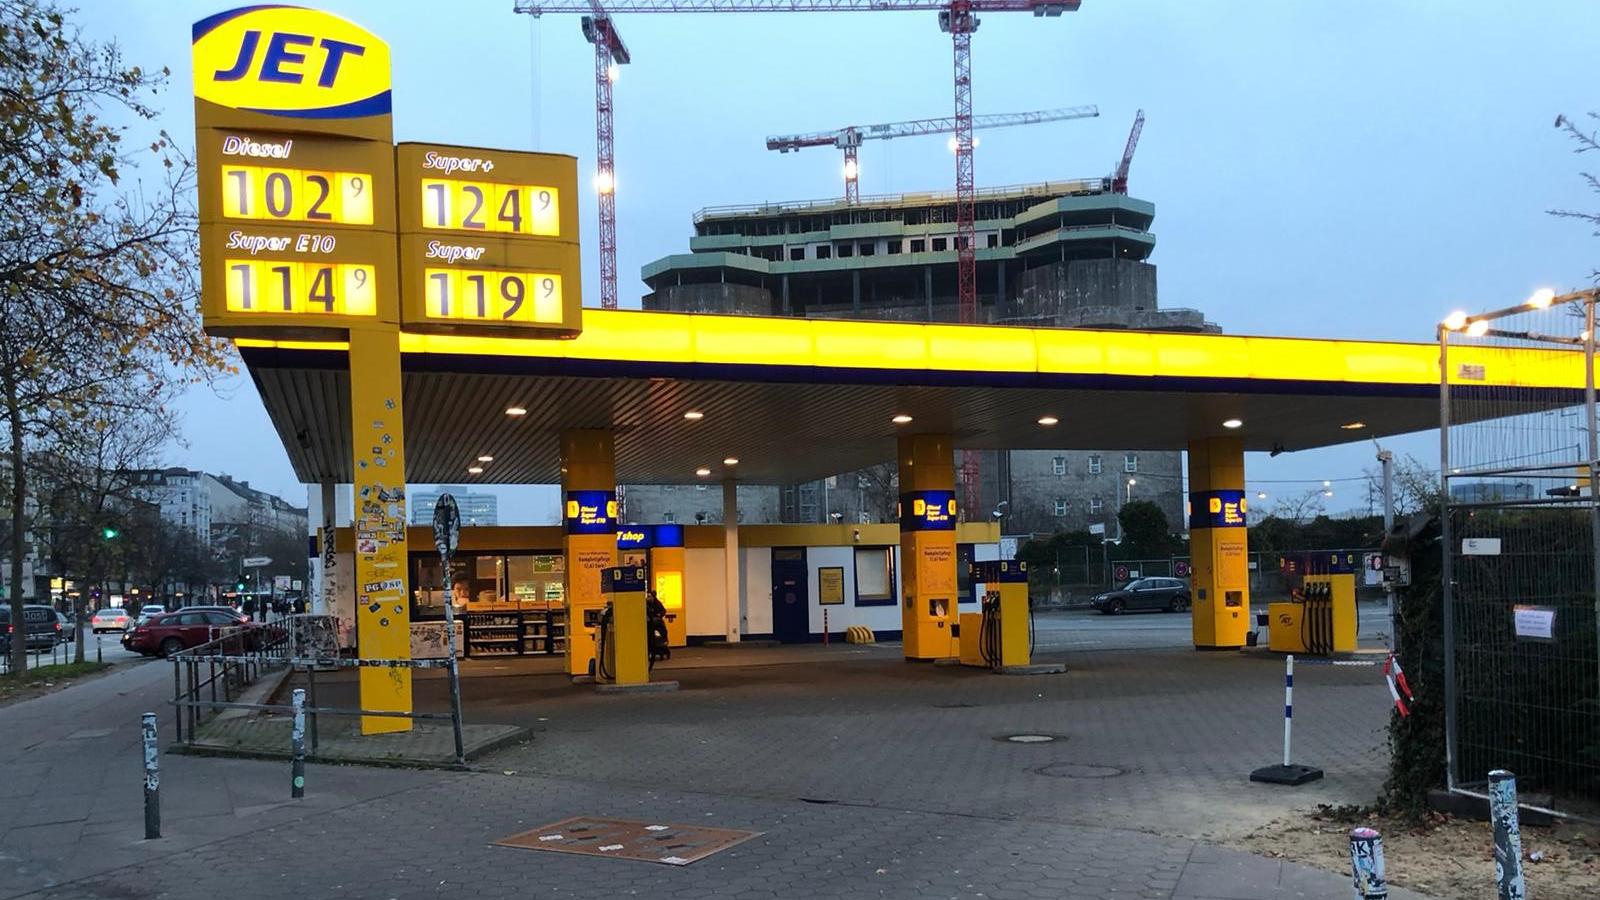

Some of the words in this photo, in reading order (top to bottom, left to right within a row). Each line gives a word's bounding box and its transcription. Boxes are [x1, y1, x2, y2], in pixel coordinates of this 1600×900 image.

[213, 31, 366, 88] JET
[222, 135, 293, 160] Diesel
[422, 151, 494, 174] Super+
[226, 230, 292, 255] Super
[295, 233, 336, 253] E10
[425, 240, 486, 263] Super
